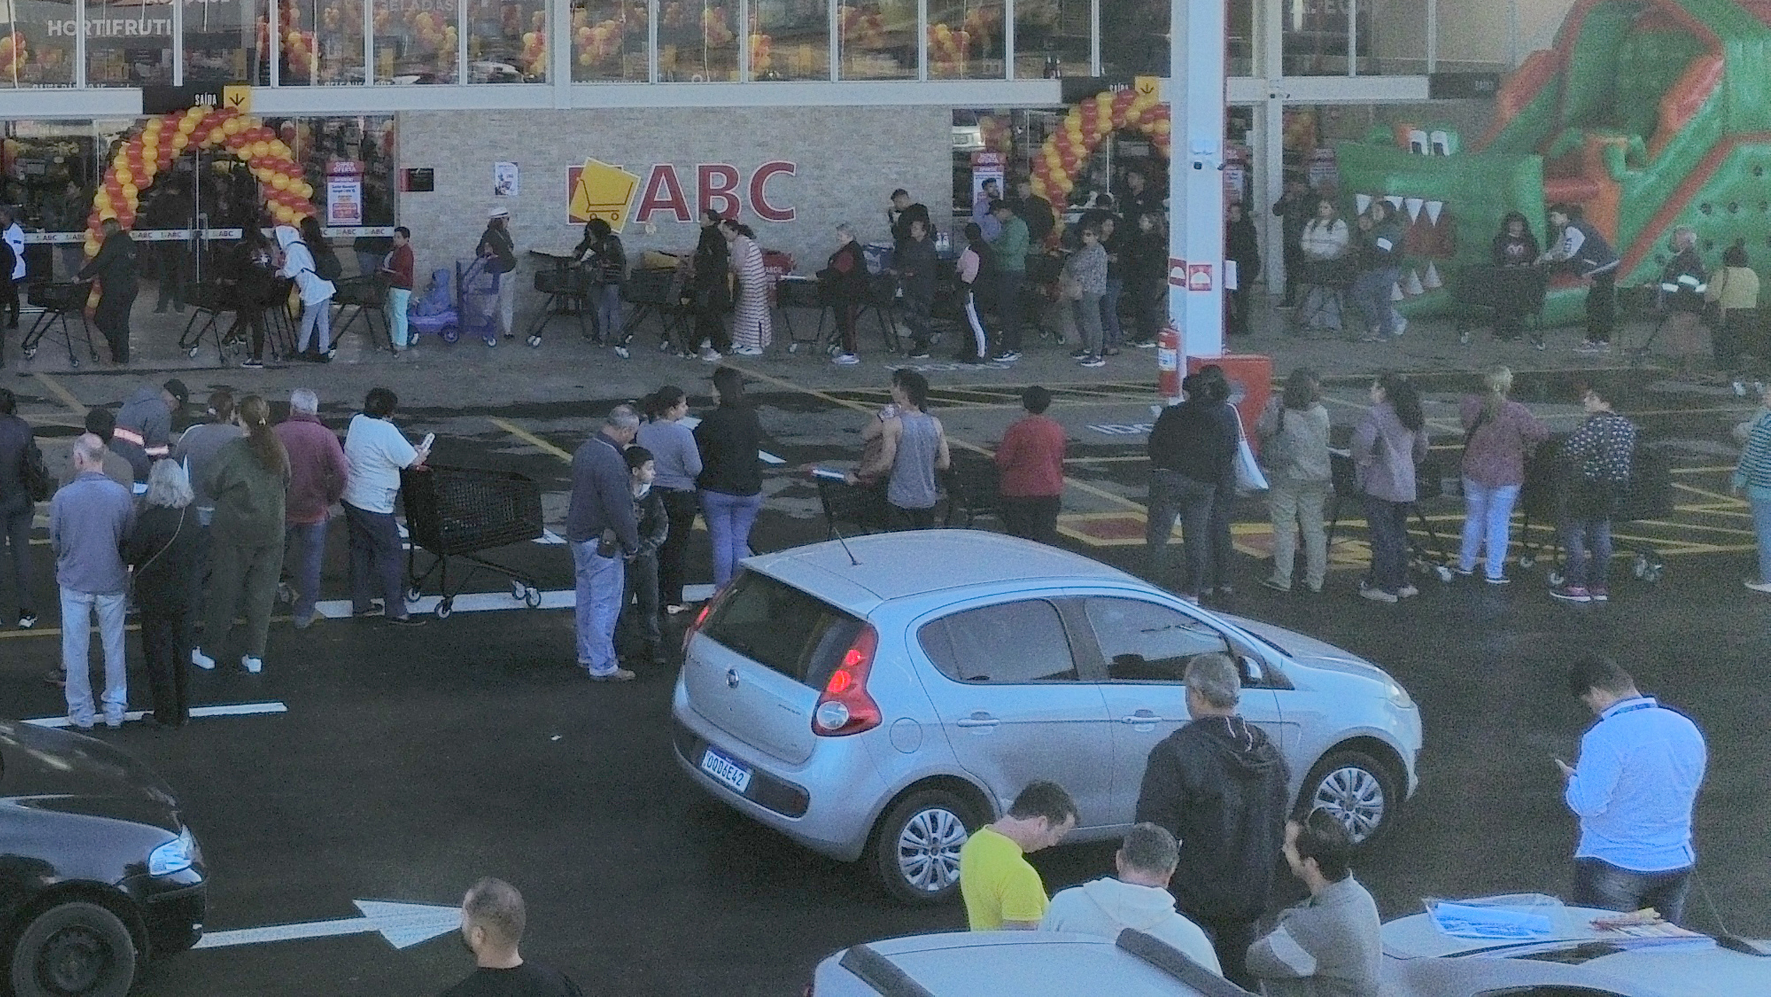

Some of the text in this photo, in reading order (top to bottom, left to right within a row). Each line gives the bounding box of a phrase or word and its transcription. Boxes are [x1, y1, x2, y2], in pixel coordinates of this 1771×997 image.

[48, 19, 171, 37] HORTIFRUTI
[194, 92, 218, 106] SAÍDA
[634, 160, 798, 222] ABC
